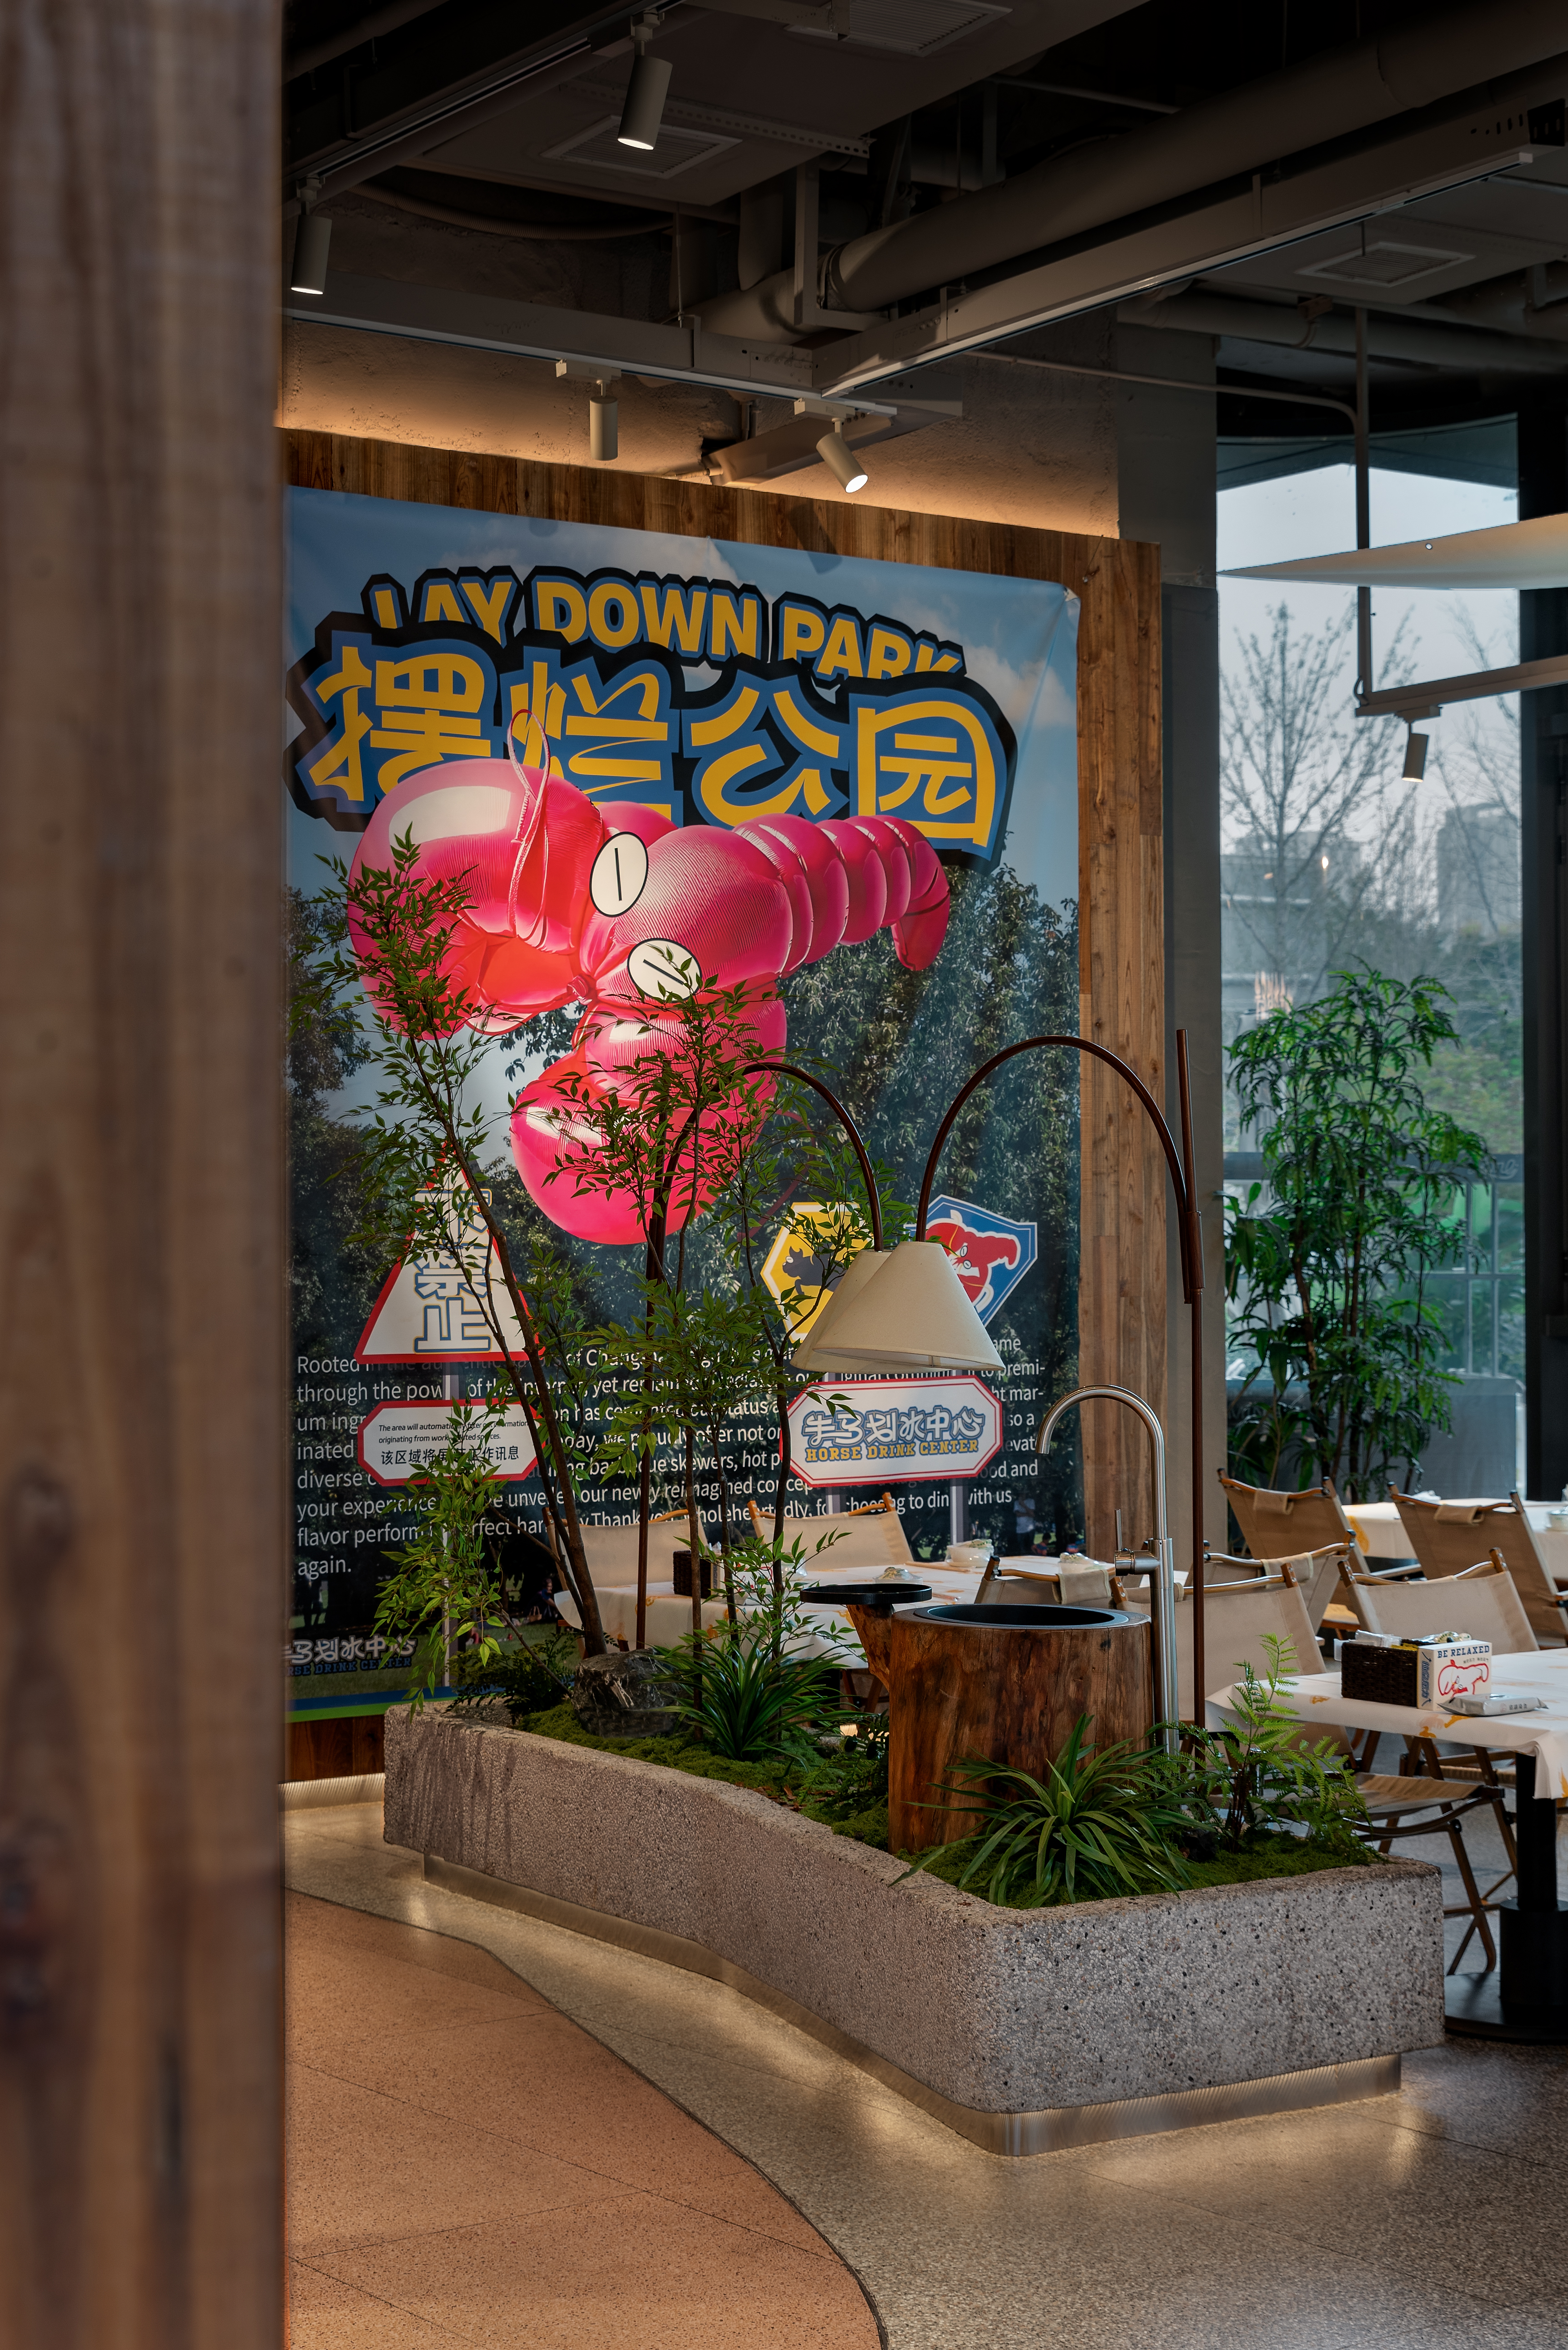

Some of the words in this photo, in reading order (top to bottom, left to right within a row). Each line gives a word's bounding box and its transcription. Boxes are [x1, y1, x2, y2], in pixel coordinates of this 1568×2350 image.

[536, 580, 759, 660] DOWN
[781, 605, 961, 680] PARK
[297, 1356, 359, 1374] Rooted
[297, 1381, 367, 1406] through
[372, 1381, 402, 1400] the
[468, 1378, 483, 1397] of
[592, 1376, 618, 1398] yet
[998, 1359, 1045, 1377] premi-
[297, 1416, 327, 1431] um
[725, 1399, 769, 1416] tatus
[1010, 1387, 1044, 1401] mar-
[297, 1439, 354, 1460] inated
[737, 1425, 764, 1441] not
[1026, 1413, 1035, 1426] a
[379, 1435, 413, 1445] originating
[805, 1446, 862, 1462] HORSE
[867, 1442, 916, 1459] DRINK
[919, 1439, 979, 1455] CENTER
[297, 1470, 362, 1489] diverse
[742, 1450, 767, 1468] hot
[297, 1502, 339, 1523] your
[580, 1488, 608, 1503] our
[612, 1485, 660, 1504] newy
[1010, 1458, 1039, 1477] and
[297, 1527, 350, 1547] flavor
[354, 1522, 424, 1548] perform
[591, 1509, 641, 1526] Thank
[908, 1494, 924, 1510] to
[996, 1490, 1012, 1503] us
[297, 1555, 352, 1580] again.
[315, 1660, 358, 1675] DRINK
[1437, 1649, 1448, 1659] BE
[1450, 1645, 1490, 1657] RELAXED
